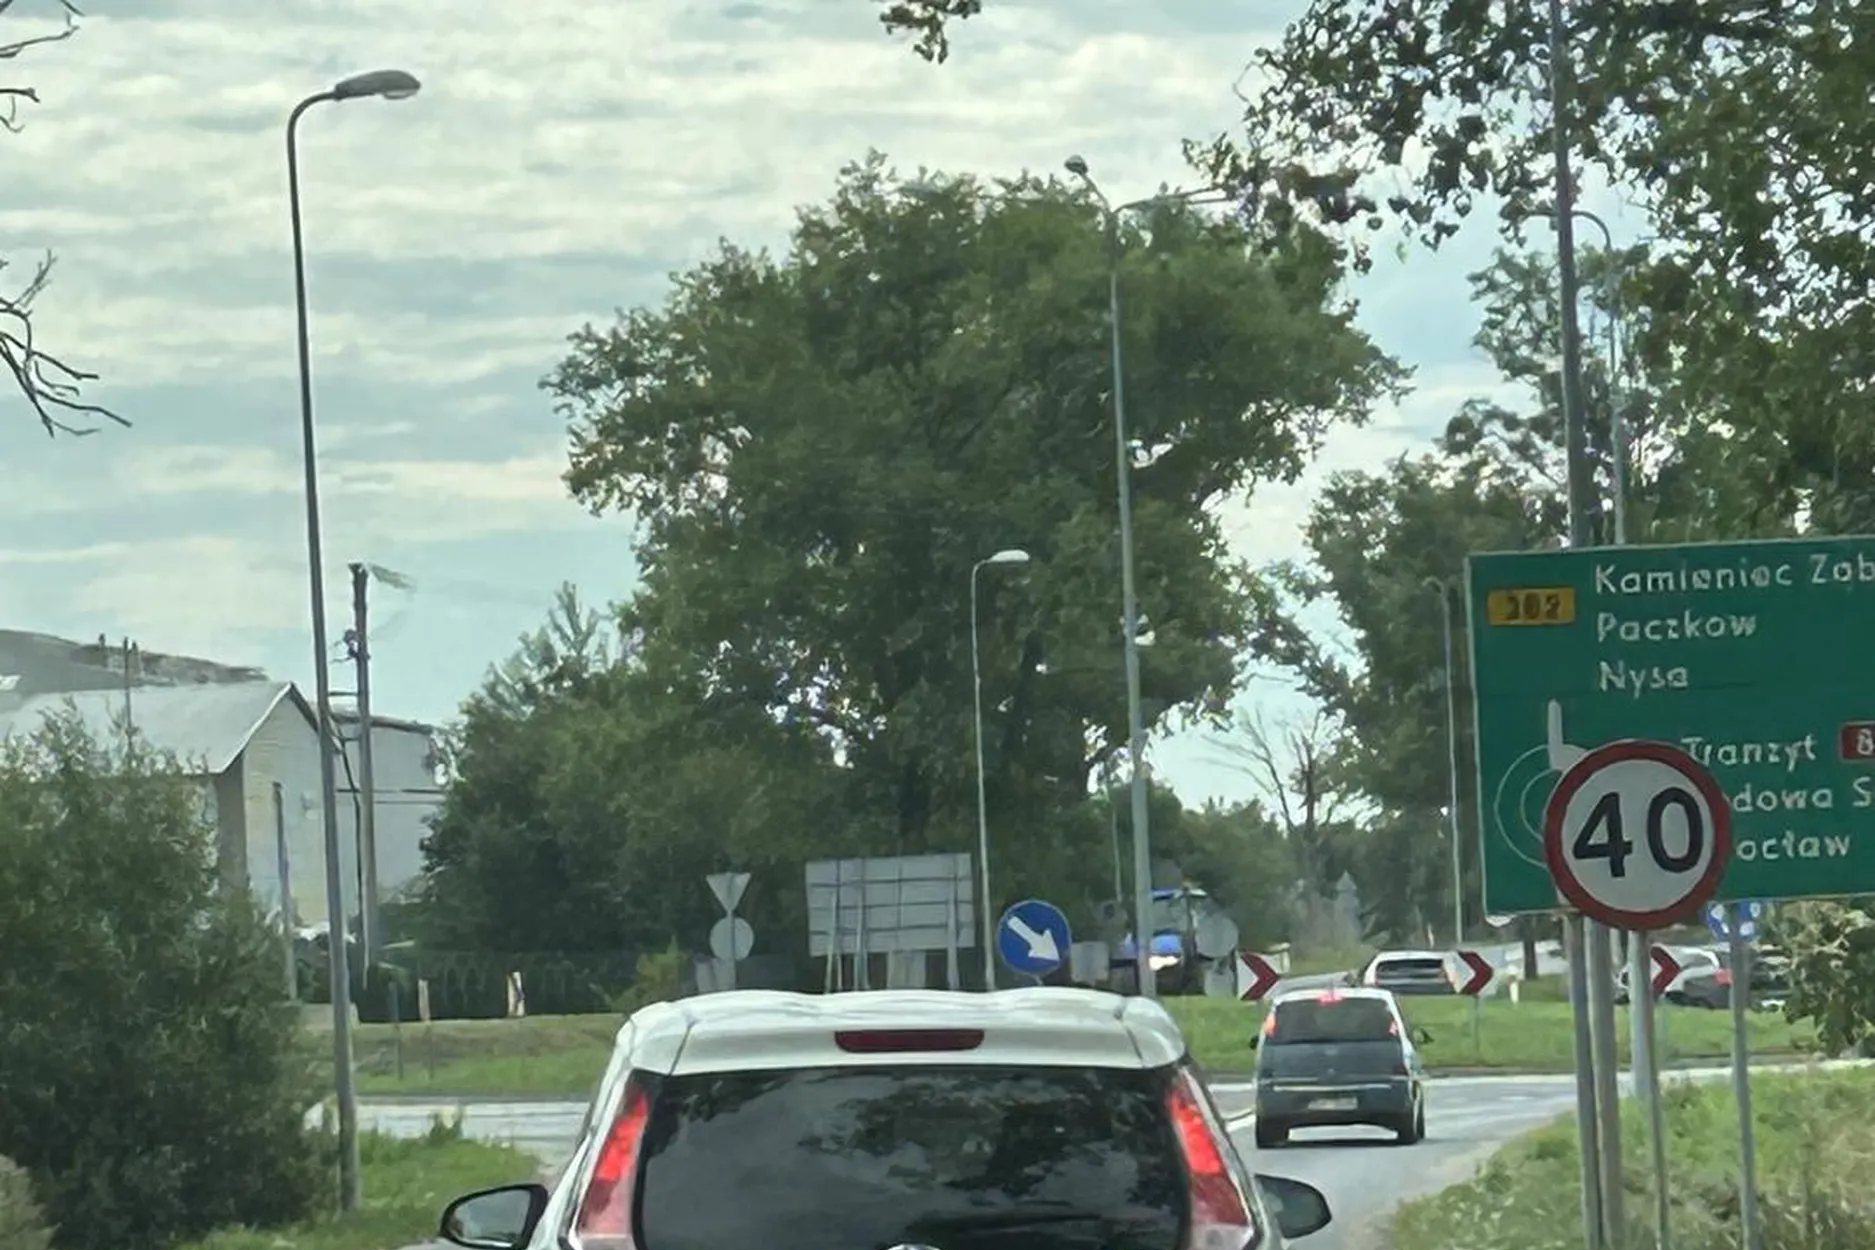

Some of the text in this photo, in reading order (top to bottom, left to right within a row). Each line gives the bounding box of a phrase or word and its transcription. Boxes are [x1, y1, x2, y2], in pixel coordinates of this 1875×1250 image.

[1595, 556, 1793, 594] Kamieniec
[1600, 659, 1688, 699] Nysa
[1681, 733, 1817, 772] Tranzyt
[1732, 782, 1833, 812] dowa
[1571, 786, 1704, 879] 40
[1736, 830, 1850, 861] ocław
